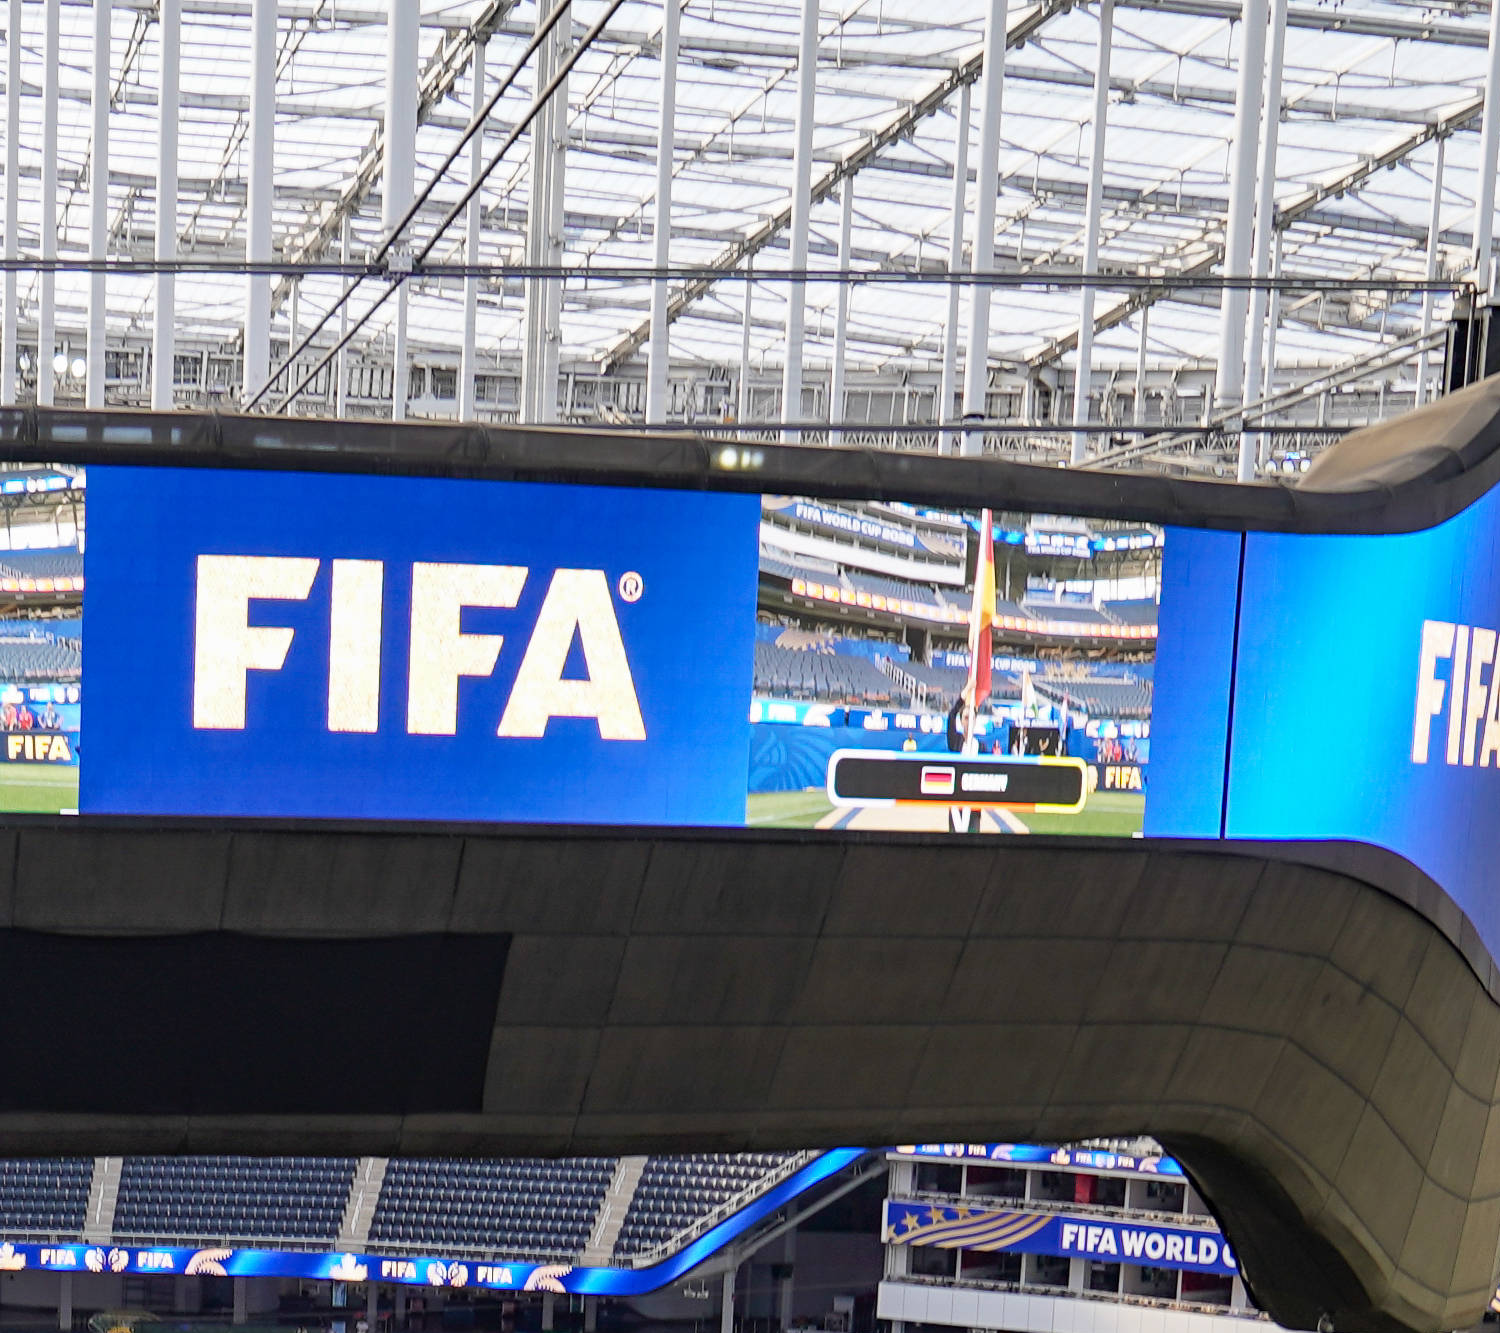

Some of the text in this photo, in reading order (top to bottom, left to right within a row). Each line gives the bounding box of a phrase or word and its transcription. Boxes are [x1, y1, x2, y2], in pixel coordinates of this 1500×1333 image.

[8, 735, 71, 761] FIFA
[1105, 766, 1142, 789] FIFA
[1062, 1222, 1116, 1254] FIFA
[1122, 1230, 1218, 1264] WORLD
[41, 1249, 76, 1266] FIFA
[138, 1252, 173, 1268] FIFA
[382, 1261, 416, 1278] FIFA
[478, 1266, 512, 1284] FIFA
